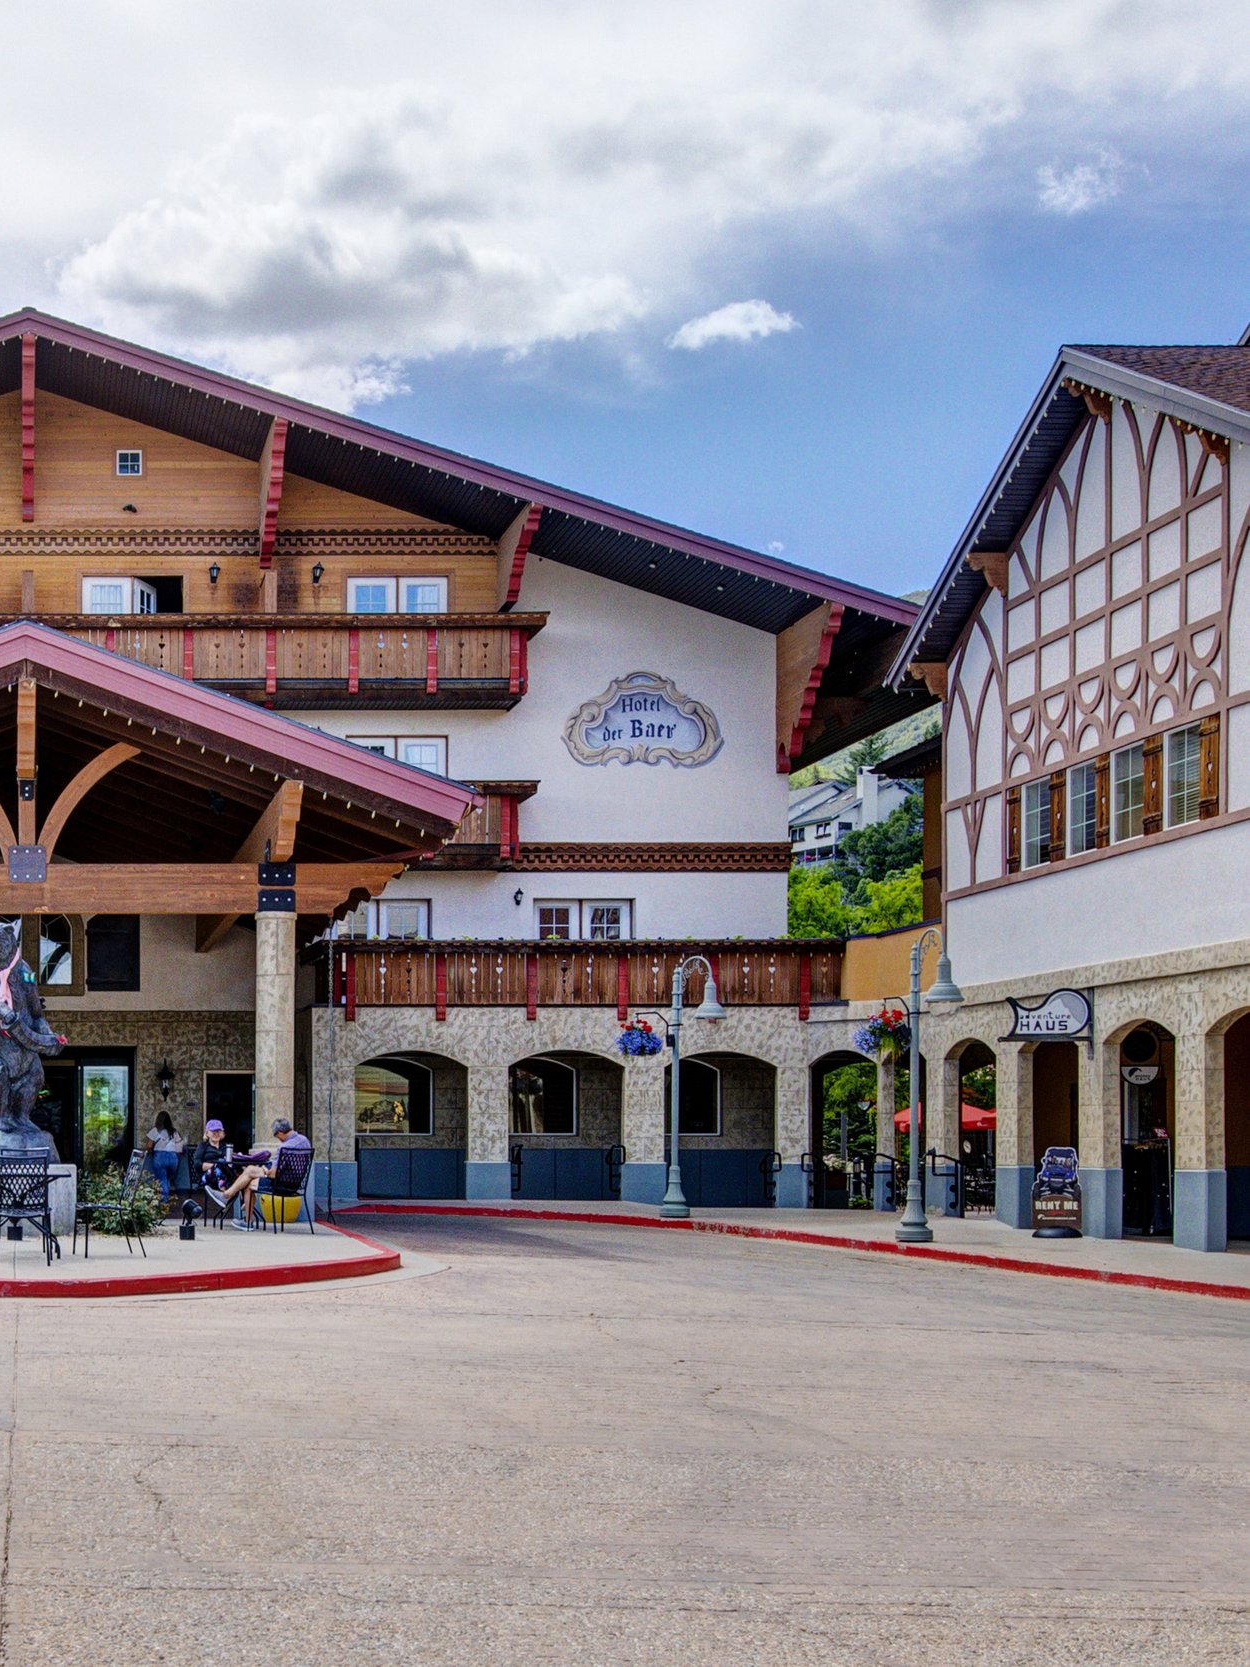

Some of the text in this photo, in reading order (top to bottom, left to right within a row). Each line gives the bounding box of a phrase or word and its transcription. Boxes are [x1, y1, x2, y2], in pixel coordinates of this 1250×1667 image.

[622, 698, 661, 713] Hotel
[603, 719, 676, 742] der Baer
[1020, 1011, 1071, 1020] adventure
[1020, 1020, 1068, 1031] HAUS
[1035, 1201, 1078, 1210] RENT ME
